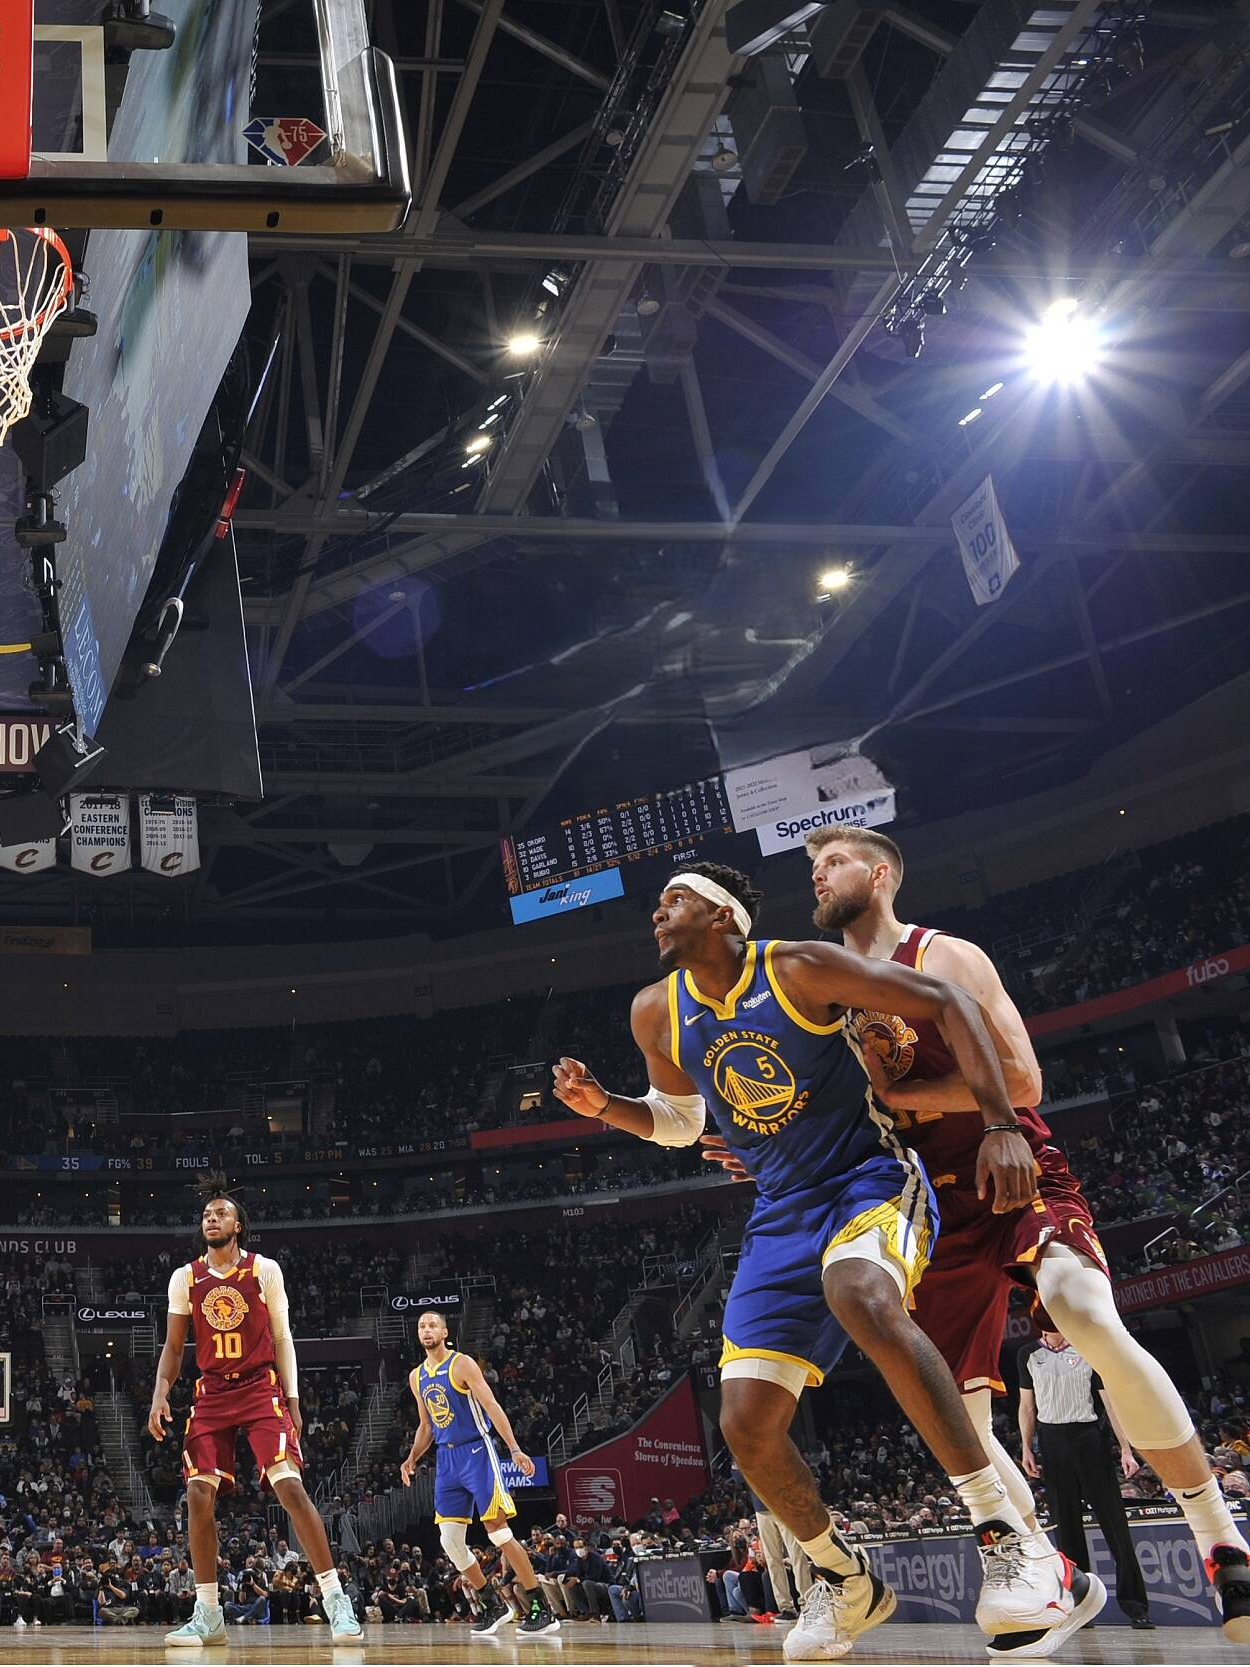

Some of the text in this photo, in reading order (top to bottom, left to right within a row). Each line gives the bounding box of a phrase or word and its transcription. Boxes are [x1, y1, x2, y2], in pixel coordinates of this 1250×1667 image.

[290, 126, 308, 142] 75
[81, 813, 120, 823] EASTERN
[776, 804, 866, 839] Spectrum
[74, 825, 127, 835] CONFERENCE
[76, 837, 126, 847] CHAMPIONS
[530, 853, 548, 863] DAVIS
[531, 858, 558, 871] GARLAND
[1186, 959, 1229, 986] fubo
[742, 990, 771, 1010] Rakuten
[704, 1031, 779, 1068] GOLDEN STATE
[755, 1056, 776, 1079] 5
[732, 1090, 810, 1136] WARRIORS
[62, 1157, 79, 1170] 35
[108, 1159, 131, 1169] FG%
[175, 1158, 209, 1169] FOULS
[304, 1151, 325, 1161] 8:17
[328, 1149, 342, 1160] PM
[562, 1207, 584, 1217] M103
[1112, 1254, 1250, 1307] PARTNER OF THE CAVALIERS
[410, 1294, 460, 1306] LEXUS
[96, 1310, 146, 1318] LEXUS
[212, 1332, 243, 1359] 10
[637, 1436, 701, 1453] The Convenience
[634, 1451, 706, 1468] Stores of Speedwa
[873, 1546, 965, 1600] tEnergy
[642, 1569, 706, 1605] FirstEnergy
